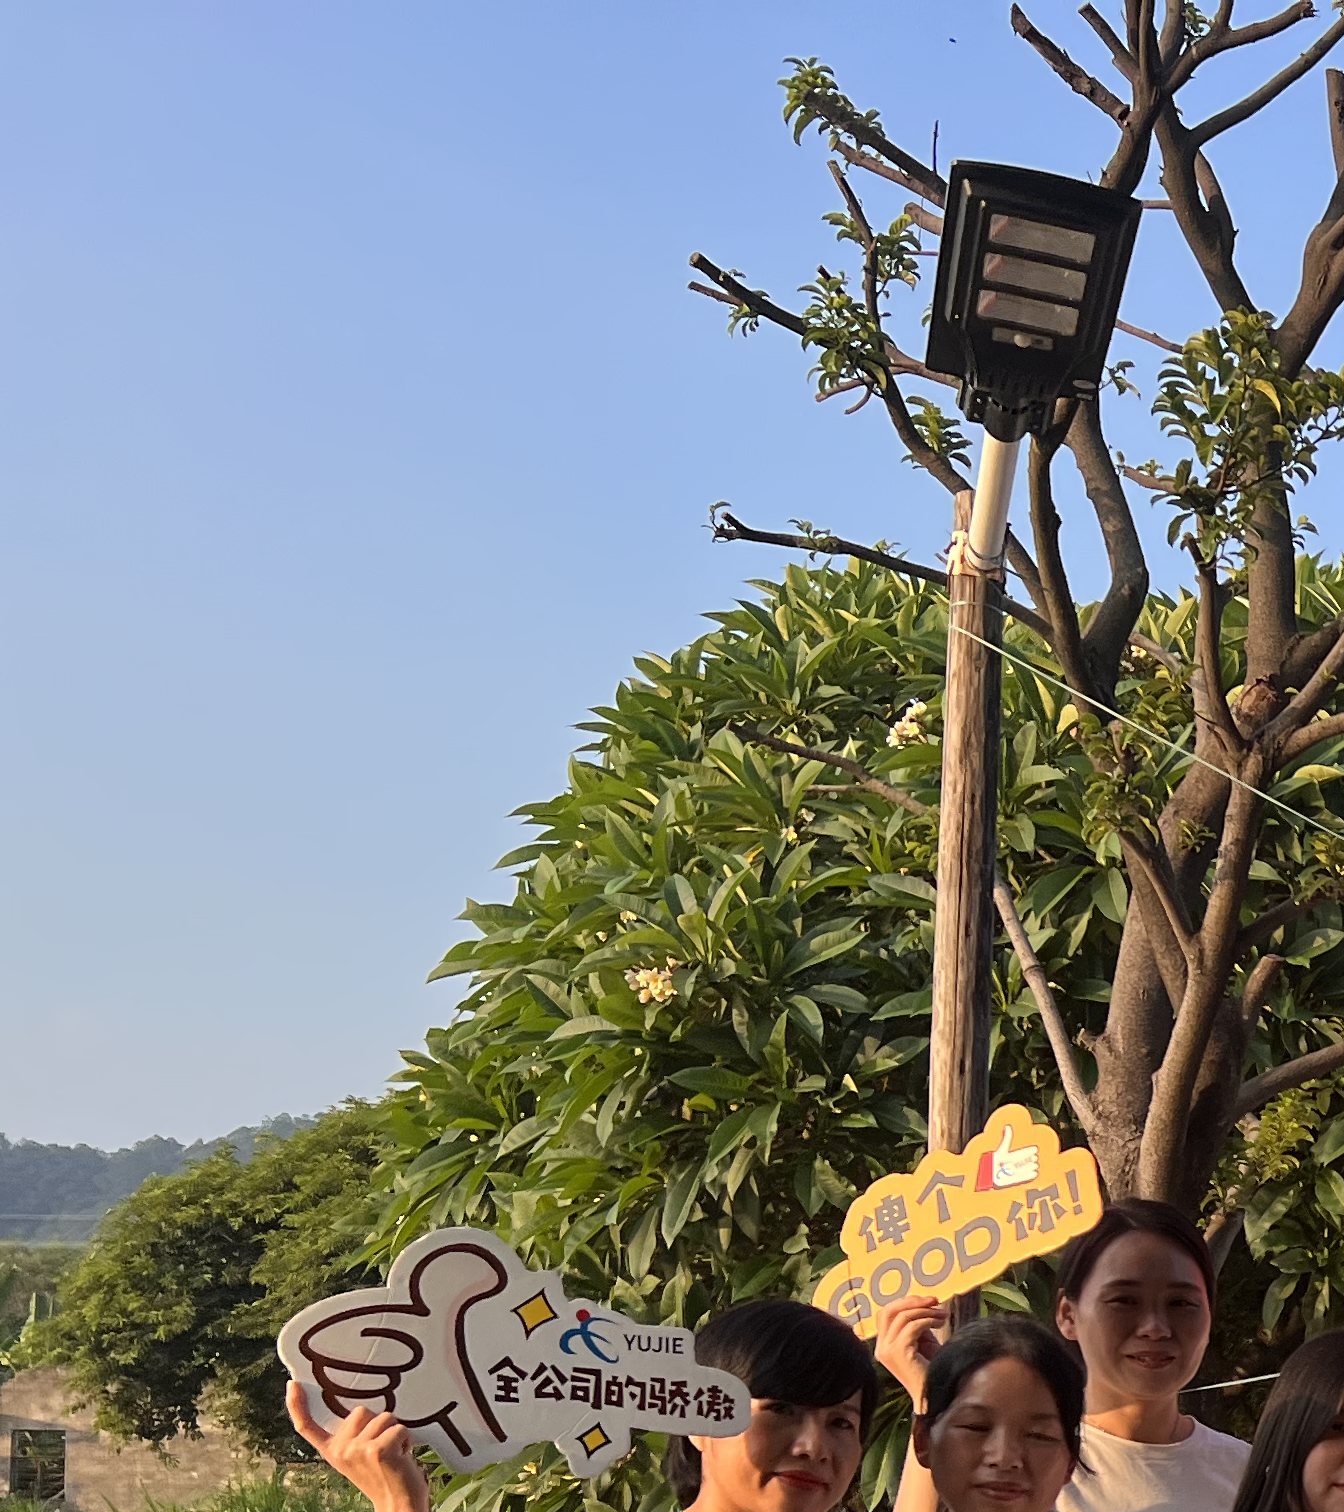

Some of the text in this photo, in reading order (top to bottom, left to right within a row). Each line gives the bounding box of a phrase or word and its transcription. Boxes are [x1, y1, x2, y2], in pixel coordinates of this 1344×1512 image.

[623, 1333, 684, 1355] YUJIE
[488, 1355, 735, 1422] 全公司的骄傲
